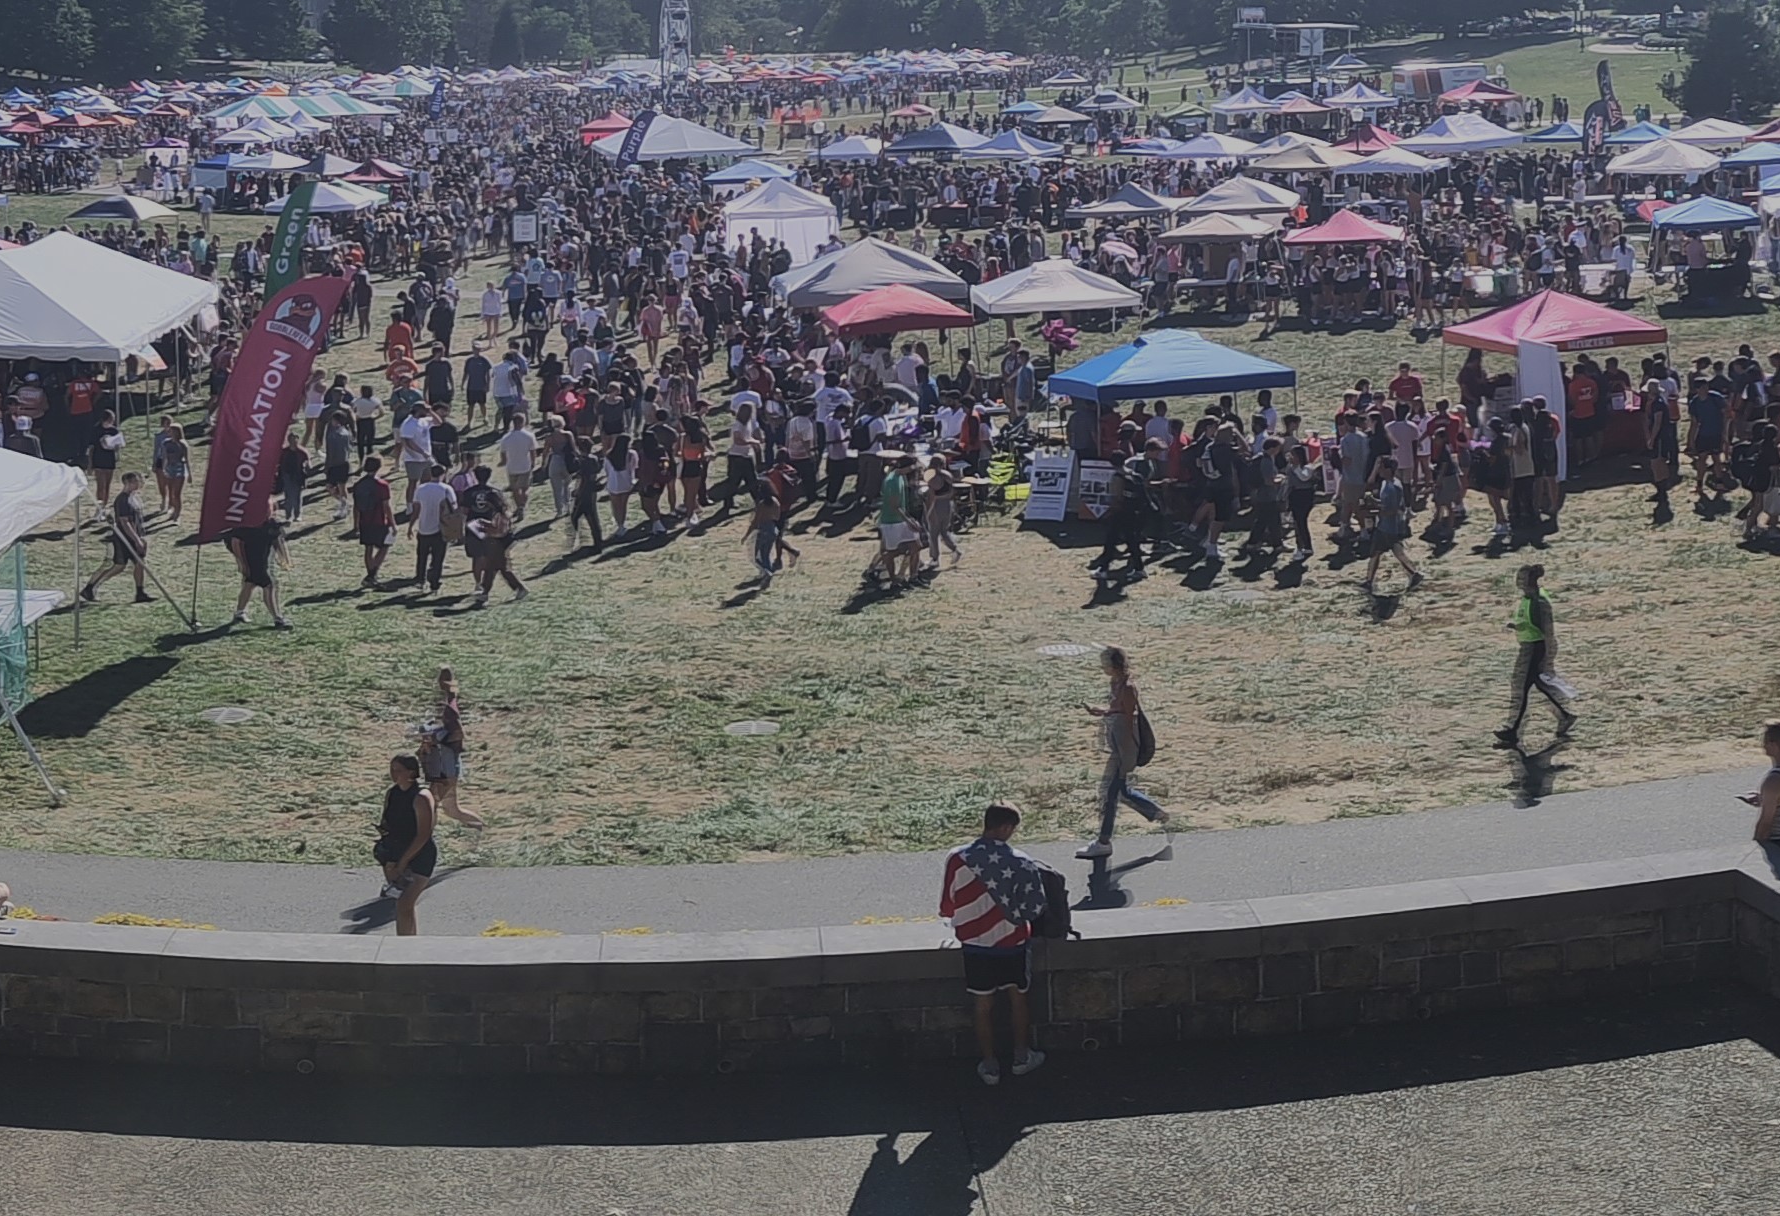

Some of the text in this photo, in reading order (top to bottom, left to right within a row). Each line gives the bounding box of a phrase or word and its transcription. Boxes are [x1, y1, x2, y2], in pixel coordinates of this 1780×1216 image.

[621, 120, 646, 162] Purple
[275, 207, 304, 274] Green
[225, 349, 292, 522] INFORMATION
